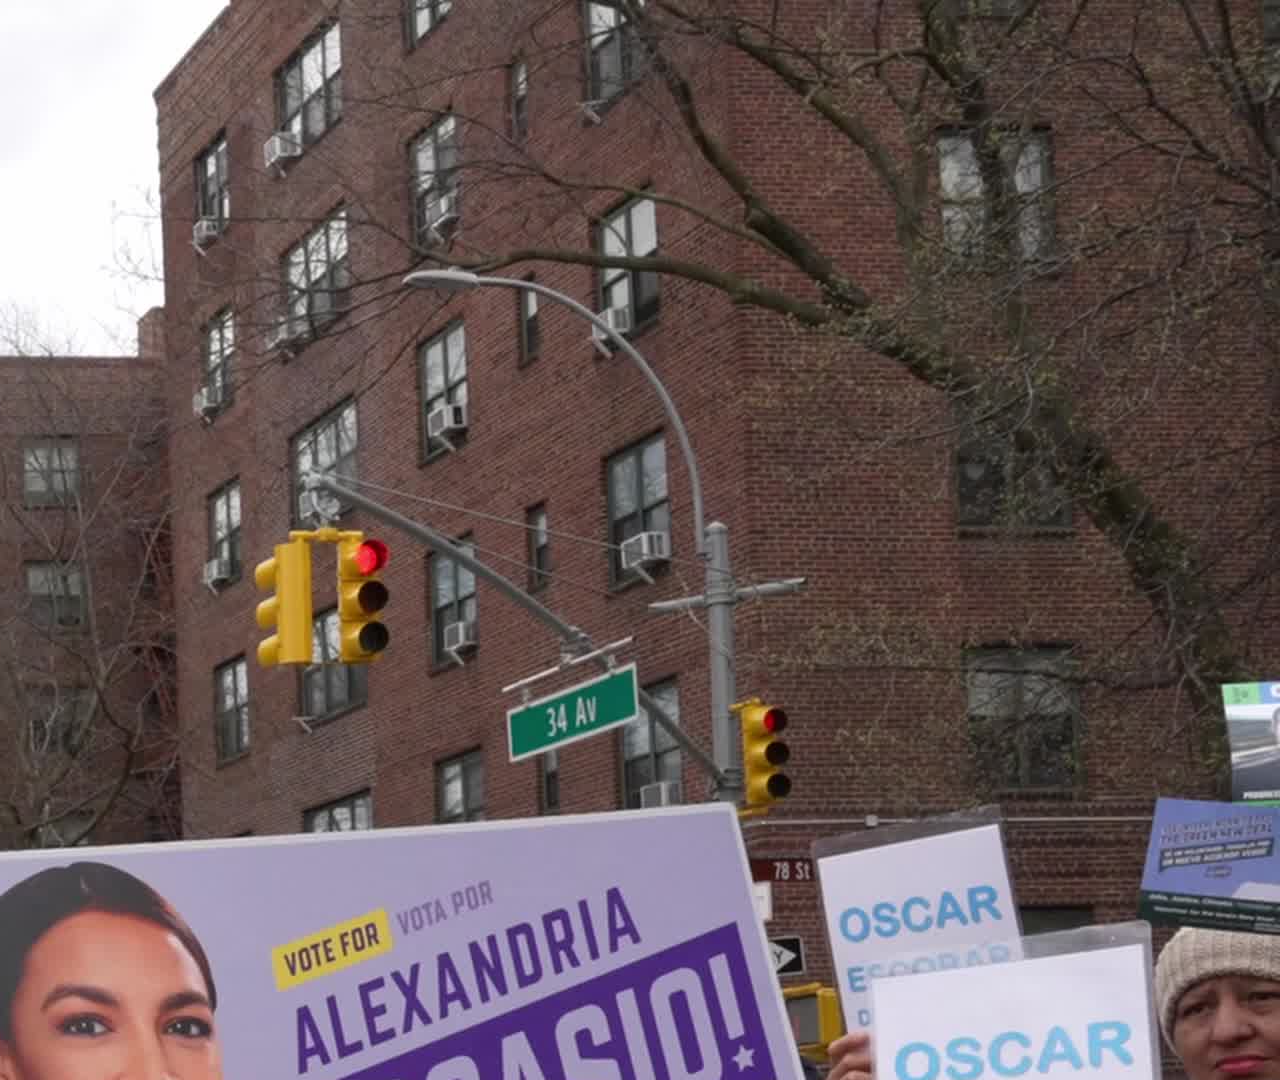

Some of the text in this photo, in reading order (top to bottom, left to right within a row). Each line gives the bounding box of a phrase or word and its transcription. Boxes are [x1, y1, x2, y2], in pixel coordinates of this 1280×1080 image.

[547, 704, 568, 737] 34
[773, 861, 811, 880] 78 St
[284, 880, 494, 977] VOTE FOR VOTA POR
[840, 885, 1003, 942] OSCAR
[296, 887, 641, 1074] ALEXANDRIA
